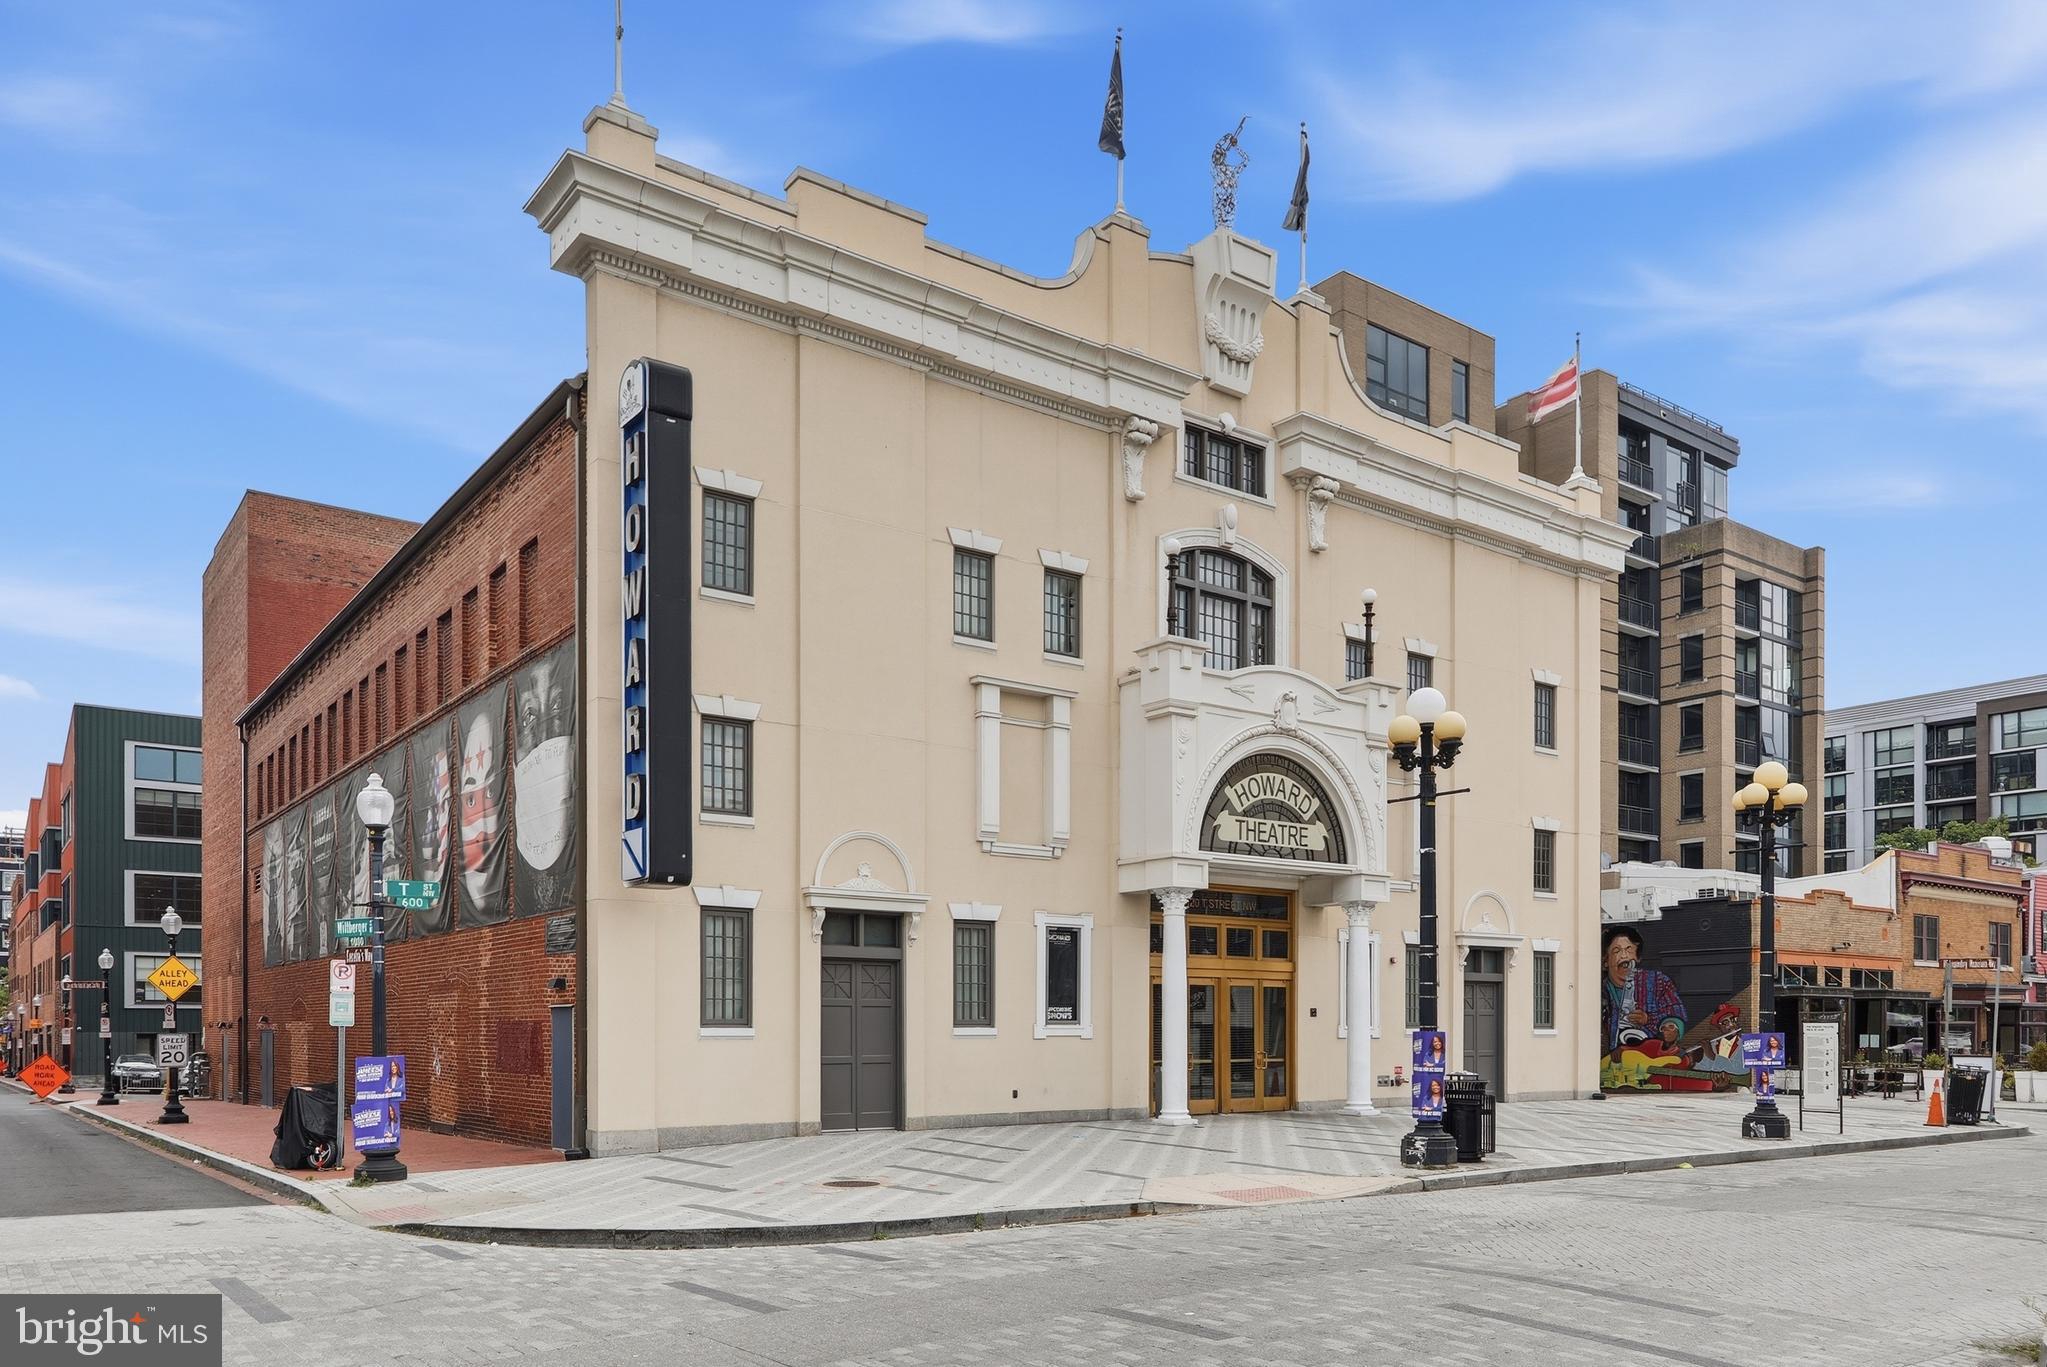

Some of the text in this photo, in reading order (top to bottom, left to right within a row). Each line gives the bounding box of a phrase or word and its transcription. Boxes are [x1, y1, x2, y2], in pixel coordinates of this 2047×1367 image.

[624, 431, 644, 821] HOWARD
[1234, 775, 1312, 815] HOWARD
[1235, 819, 1309, 847] THEATRE
[399, 883, 410, 896] T
[402, 898, 423, 907] 600
[161, 1051, 185, 1063] 20
